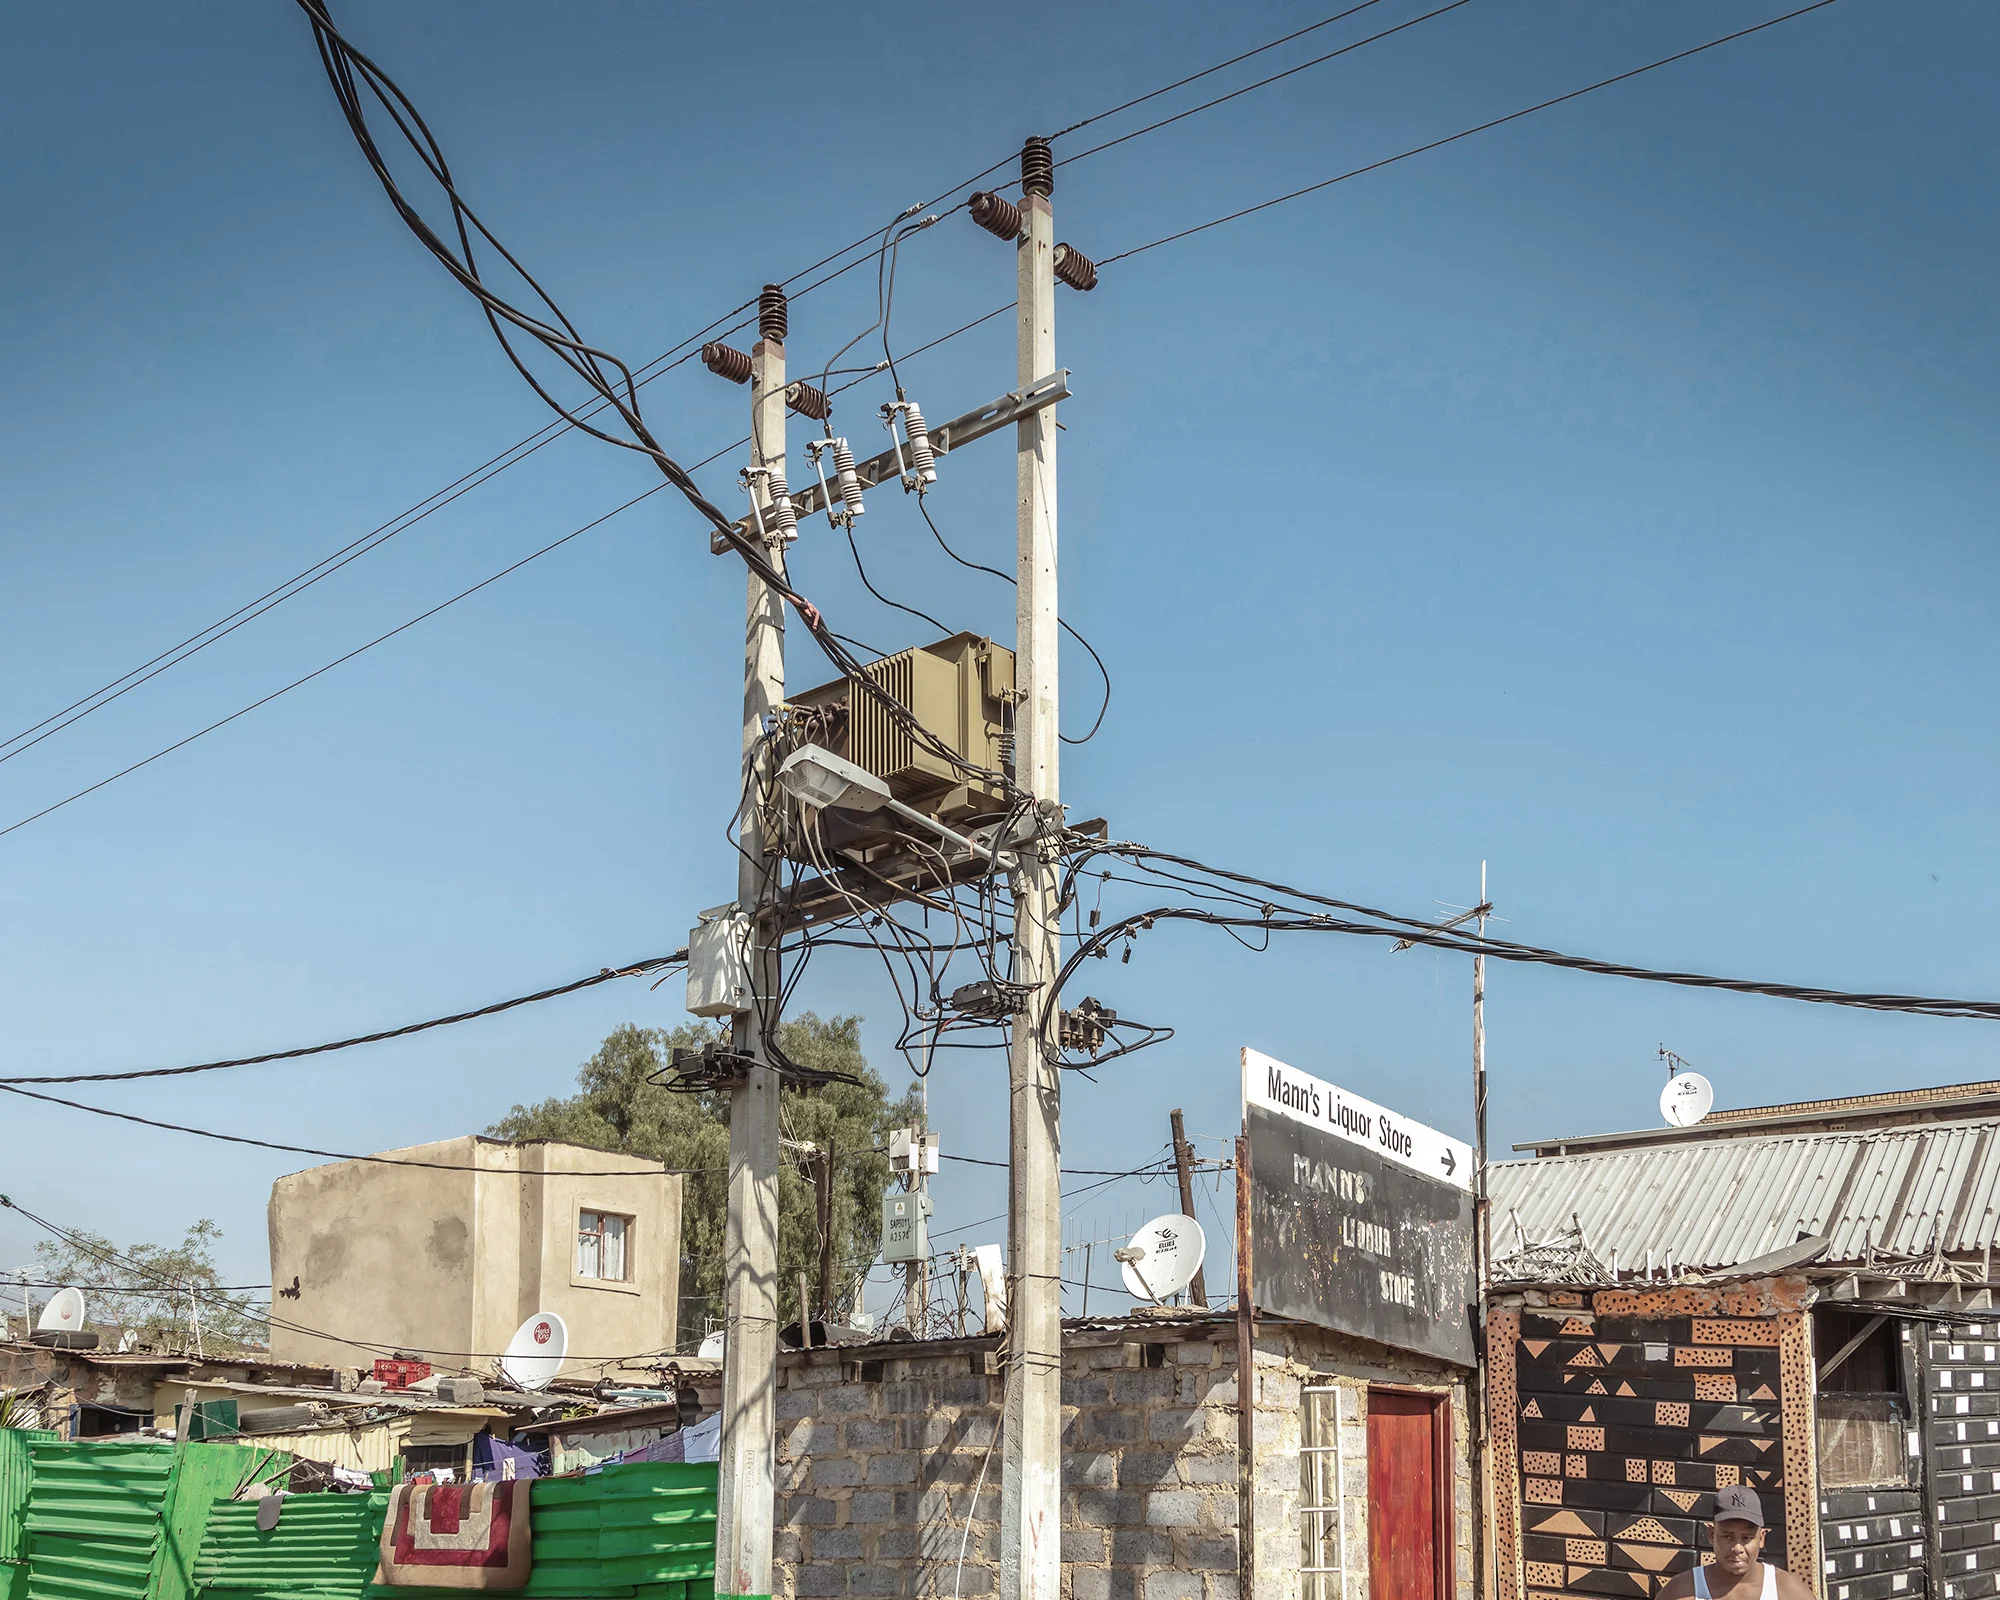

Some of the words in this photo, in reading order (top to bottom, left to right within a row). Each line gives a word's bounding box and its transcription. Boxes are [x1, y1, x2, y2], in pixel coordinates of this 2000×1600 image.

[1267, 1065, 1320, 1118] Mann's
[1328, 1091, 1372, 1139] Liquor
[1379, 1114, 1412, 1158] Store
[1380, 1270, 1416, 1309] STORE
